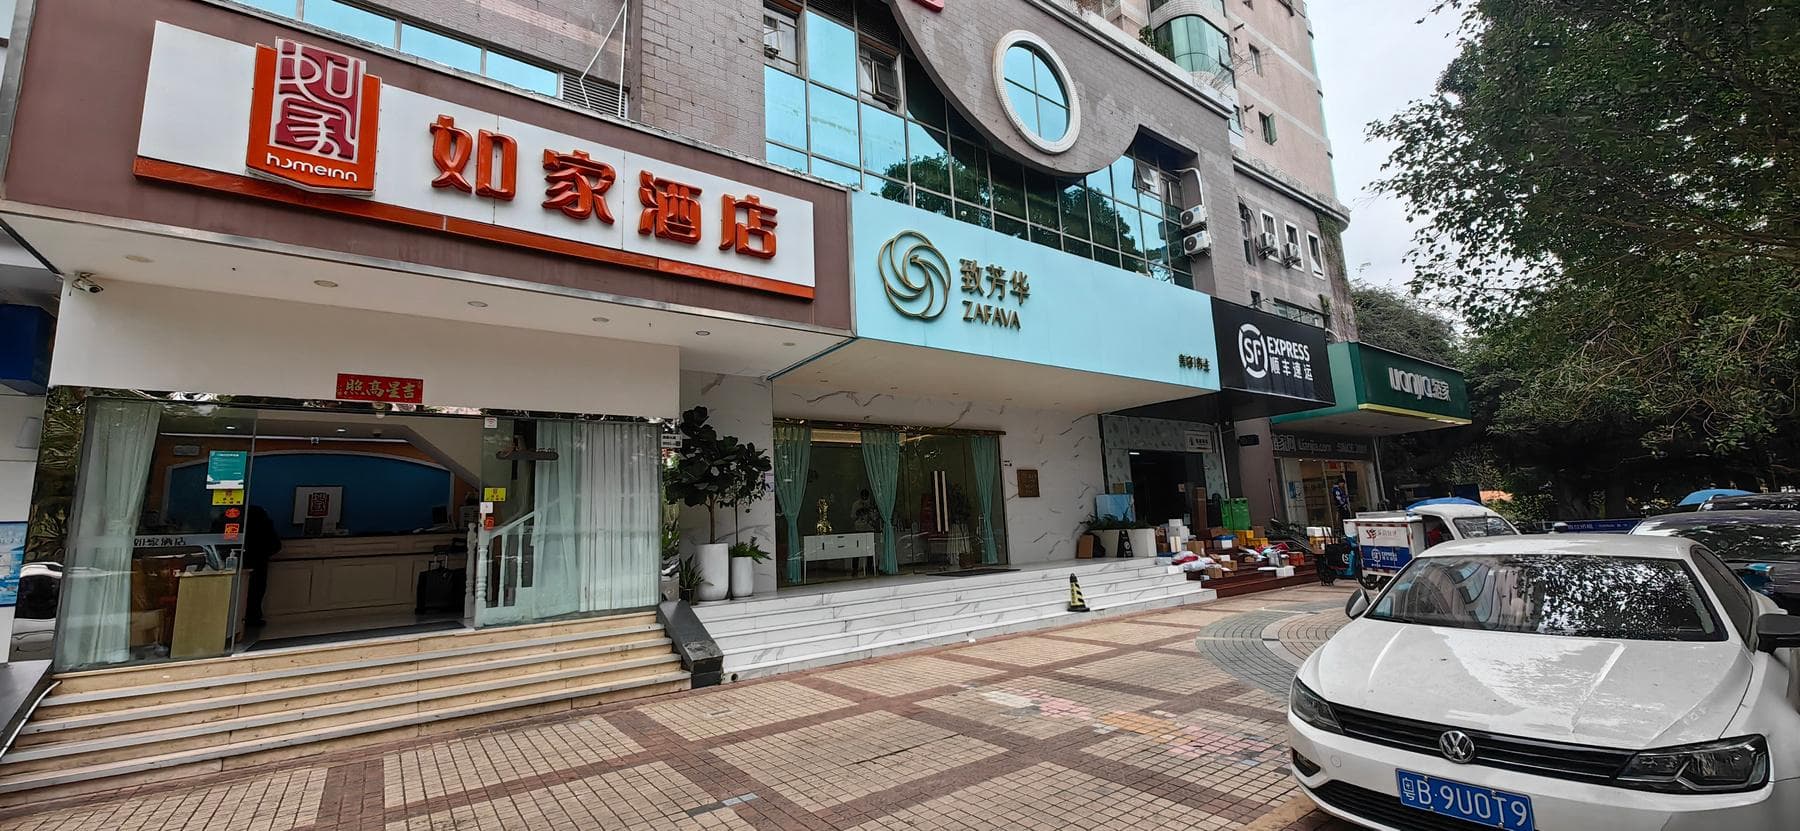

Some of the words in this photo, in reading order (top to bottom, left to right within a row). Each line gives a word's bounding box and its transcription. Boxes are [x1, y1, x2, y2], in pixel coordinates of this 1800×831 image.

[429, 113, 778, 260] 如家酒店
[959, 257, 1031, 306] 致芳华
[962, 300, 1021, 332] ZAFAVA
[1266, 335, 1311, 362] EXPRESS
[1269, 355, 1314, 381] 顺丰速运
